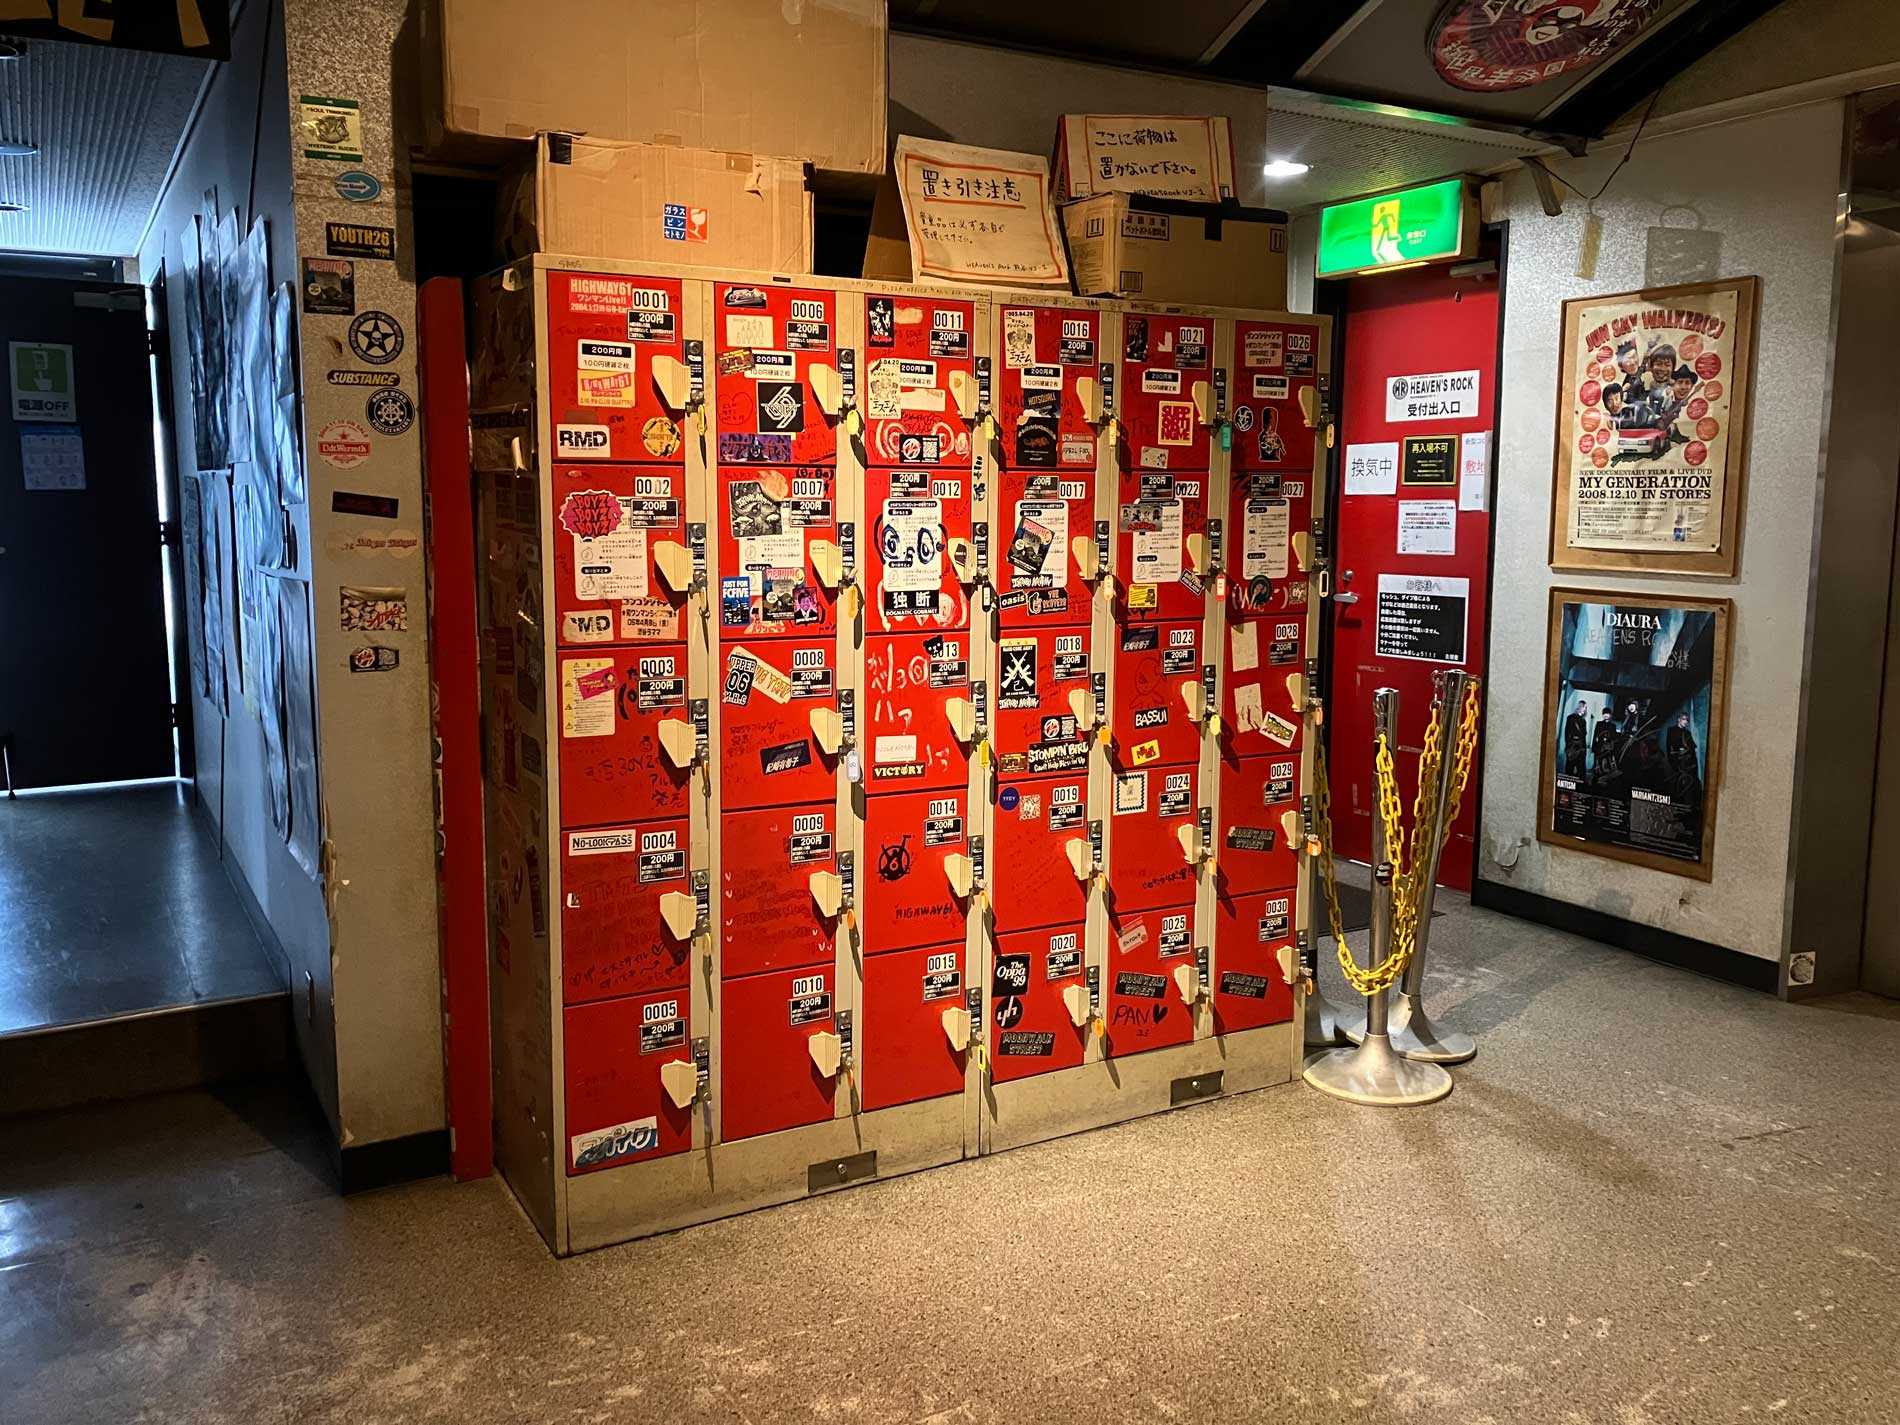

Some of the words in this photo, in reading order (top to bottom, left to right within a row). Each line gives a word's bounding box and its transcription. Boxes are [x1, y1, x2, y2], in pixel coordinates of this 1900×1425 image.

[1095, 128, 1178, 146] ここに荷物は
[1100, 157, 1197, 180] 置かないで下さい。
[922, 169, 1021, 201] 置き引き注意
[665, 205, 686, 216] ガラス
[330, 226, 390, 246] YOUTH26
[664, 229, 686, 239] セトモノ
[570, 278, 633, 296] HIGHWAY61
[633, 291, 667, 309] 0001
[792, 302, 823, 319] 0006
[638, 313, 664, 324] 200円
[934, 312, 962, 329] 0011
[796, 324, 820, 334] 200円
[1063, 322, 1088, 337] 0016
[1180, 328, 1203, 342] 0021
[1586, 323, 1610, 352] JUN
[1611, 313, 1638, 338] SKY
[938, 332, 960, 342] 200円
[1288, 335, 1310, 349] 0026
[1067, 341, 1087, 350] 200円
[1182, 346, 1200, 355] 200円
[1291, 354, 1308, 363] 200円
[329, 372, 398, 385] SUBSTANCE
[1410, 379, 1448, 394] HEAVEN'S
[1450, 376, 1474, 391] ROCK
[1407, 401, 1461, 417] 受付出入口
[1411, 442, 1449, 454] 再入場不可
[1351, 457, 1392, 477] 換気中
[899, 474, 920, 483] 200円
[1032, 477, 1051, 486] 200円
[1148, 477, 1166, 485] 200円
[1258, 476, 1275, 484] 200円
[1579, 476, 1603, 489] MY
[1605, 475, 1712, 489] GENERATION
[793, 481, 823, 496] 0007
[933, 482, 960, 497] 0012
[1060, 483, 1084, 497] 0017
[1578, 489, 1637, 499] 2008.12.10
[1641, 489, 1656, 499] IN
[1659, 489, 1712, 499] STORES
[573, 495, 609, 508] BOYZ
[642, 501, 667, 511] 200円
[799, 501, 822, 511] 200円
[574, 508, 609, 521] BOYZ
[576, 521, 609, 535] BOYZ
[737, 580, 748, 588] FOR
[892, 591, 931, 609] 独断
[1002, 594, 1025, 606] oasis
[1606, 613, 1662, 630] DIAURA
[1171, 631, 1193, 644] 0023
[1056, 638, 1081, 651] 0018
[1276, 643, 1292, 651] 200円
[794, 651, 824, 666] 0008
[1062, 656, 1081, 664] 200円
[1171, 651, 1188, 659] 200円
[731, 655, 757, 673] UPPER
[727, 670, 750, 692] 06
[801, 671, 823, 681] 200円
[649, 681, 674, 690] 200円
[1135, 710, 1168, 726] BASSUI
[874, 764, 924, 777] VICTORY
[1271, 765, 1292, 777] 0029
[1166, 775, 1189, 789] 0024
[1272, 782, 1287, 790] 200円
[1557, 780, 1576, 790] ANTISM
[1054, 788, 1078, 802] 0019
[1167, 793, 1184, 802] 200円
[930, 801, 956, 816] 0014
[1057, 805, 1076, 815] 200円
[794, 816, 824, 832] 0009
[934, 820, 954, 829] 200円
[643, 833, 675, 850] 0004
[800, 836, 822, 846] 200円
[650, 853, 675, 864] 200円
[1266, 900, 1287, 914] 0030
[1163, 917, 1185, 931] 0025
[1266, 919, 1282, 927] 200円
[1051, 936, 1075, 951] 0020
[1167, 935, 1184, 943] 200円
[928, 955, 954, 970] 0015
[1010, 961, 1024, 969] The
[1055, 954, 1073, 964] 200円
[933, 974, 953, 984] 200円
[996, 966, 1026, 980] Oppa
[793, 977, 823, 994] 0010
[1012, 976, 1026, 987] 99
[800, 997, 822, 1008] 200円
[644, 1002, 676, 1021] 0005
[1112, 1005, 1150, 1025] PAN
[651, 1023, 675, 1034] 200円
